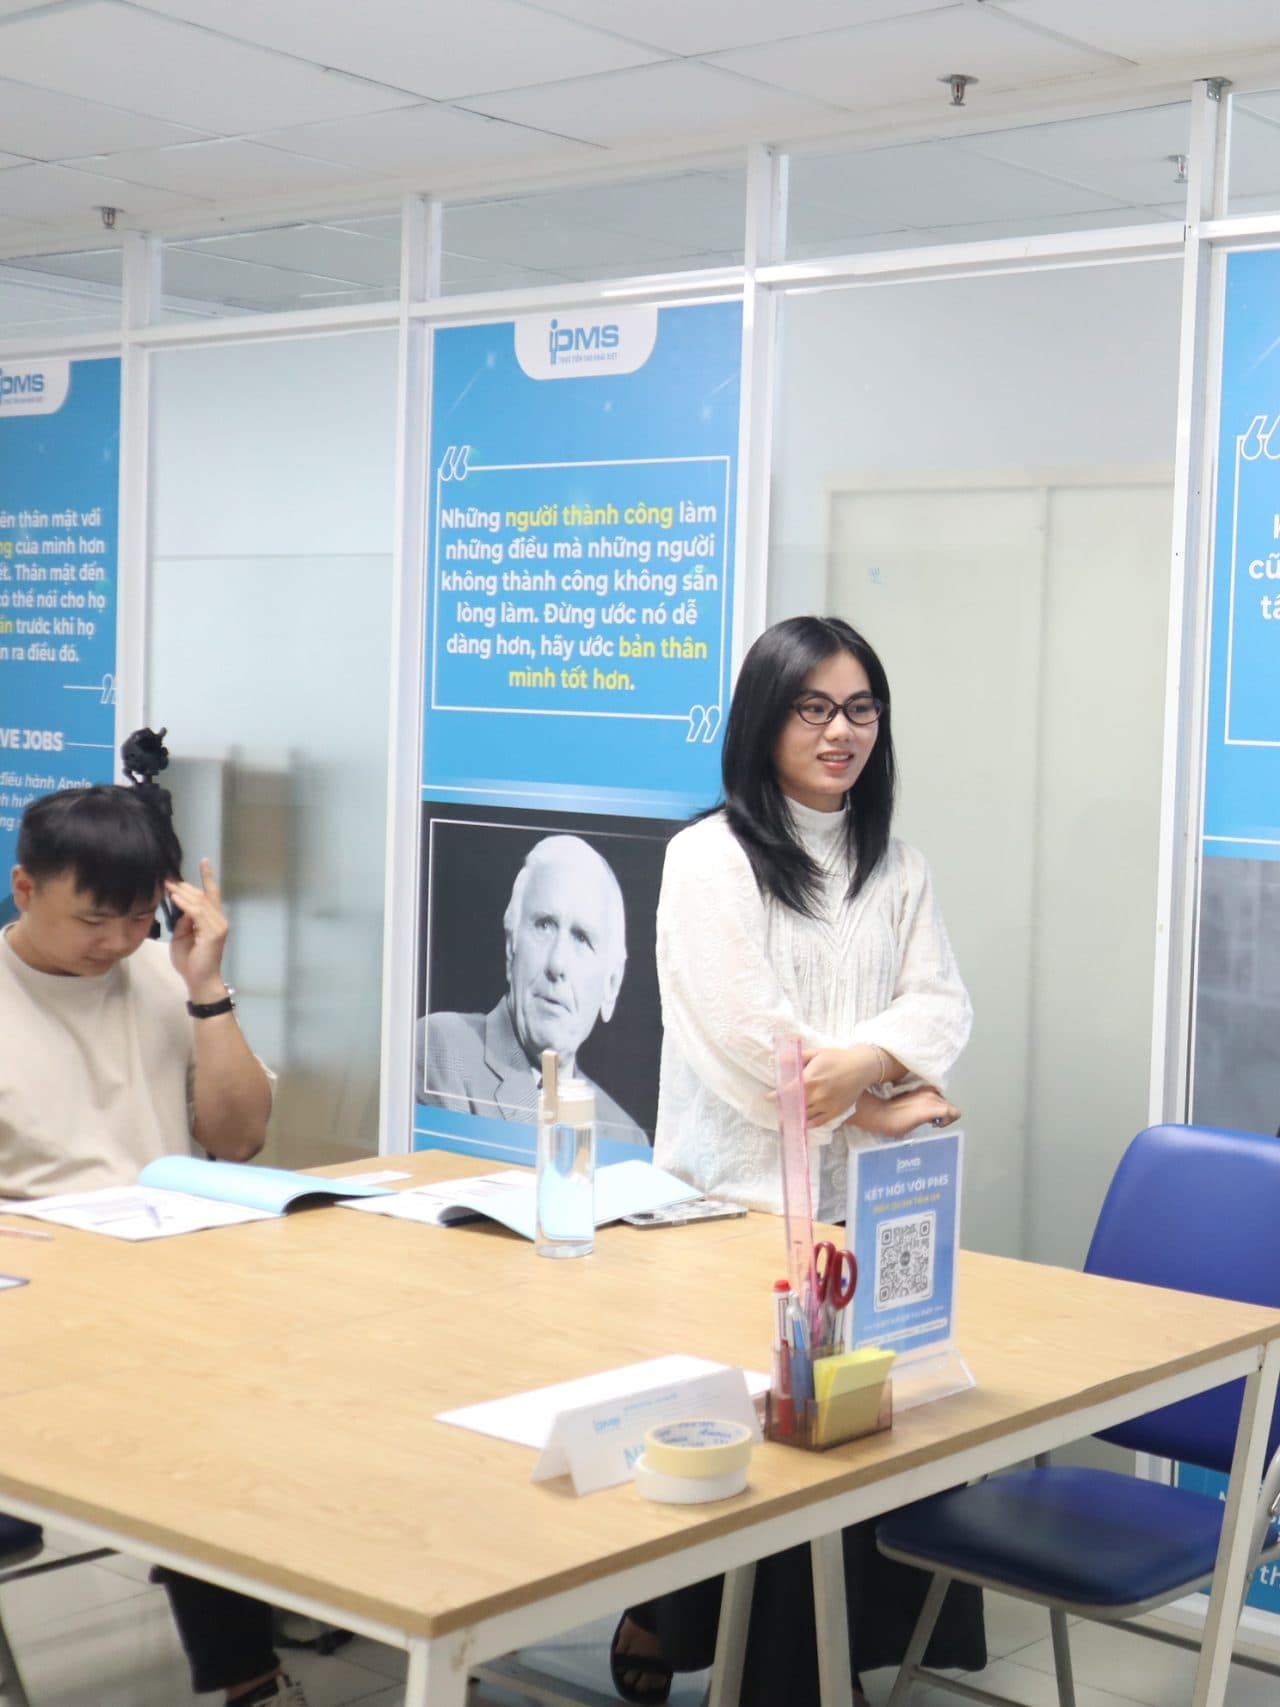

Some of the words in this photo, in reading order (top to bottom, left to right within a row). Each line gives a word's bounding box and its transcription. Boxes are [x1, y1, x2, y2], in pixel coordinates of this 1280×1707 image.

[441, 508, 500, 531] Những
[505, 504, 558, 531] người
[563, 504, 619, 526] thành
[624, 504, 673, 530] công
[679, 501, 717, 524] làm
[446, 537, 503, 564] những
[508, 536, 548, 559] điều
[553, 536, 582, 559] mà
[588, 534, 651, 562] những
[656, 534, 715, 561] người
[441, 570, 497, 596] không
[502, 569, 556, 592] thành
[561, 570, 608, 596] công
[614, 570, 677, 596] không
[682, 564, 718, 591] sẵn
[457, 602, 496, 628] lòng
[501, 602, 539, 624] làm.
[544, 603, 596, 629] Đừng
[601, 605, 636, 625] ước
[642, 605, 667, 625] nó
[672, 598, 698, 625] dễ
[446, 633, 491, 659] dàng
[496, 634, 536, 659] hơn,
[541, 634, 574, 661] hãy
[579, 636, 614, 657] ước
[619, 634, 656, 658] bản
[662, 637, 708, 660] thân
[509, 666, 556, 688] mình
[561, 665, 588, 689] tốt
[593, 666, 636, 691] hơn.
[23, 729, 64, 751] JOBS
